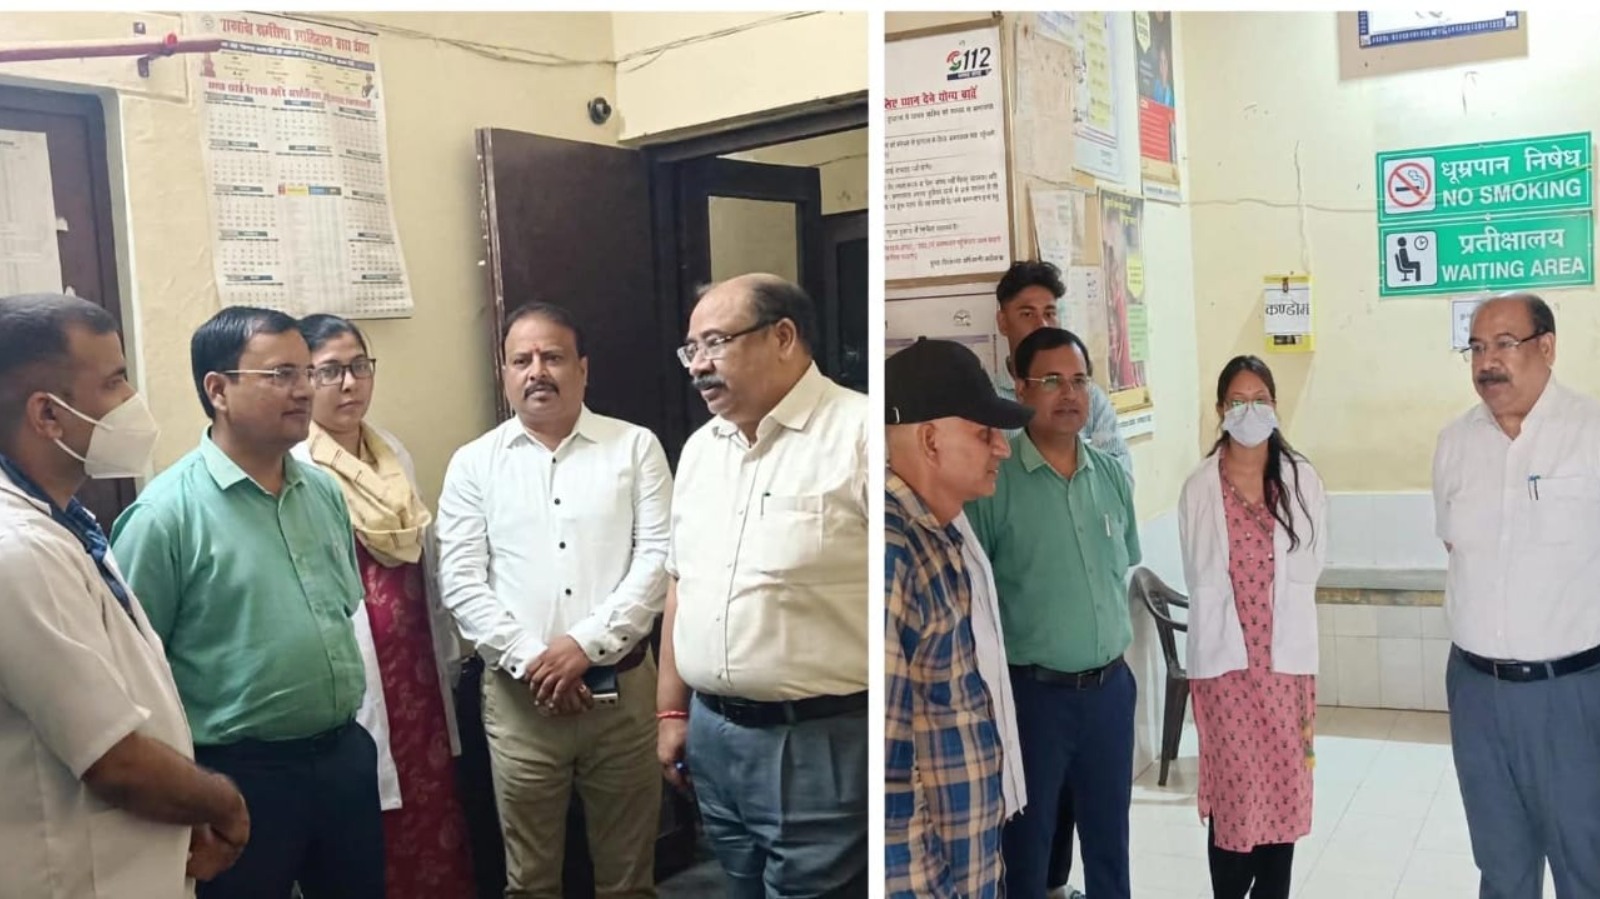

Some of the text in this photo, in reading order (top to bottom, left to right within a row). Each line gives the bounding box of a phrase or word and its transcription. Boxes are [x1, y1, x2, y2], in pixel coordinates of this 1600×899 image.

[963, 46, 991, 70] 112
[901, 95, 920, 107] ध्यान
[922, 91, 936, 103] देने
[938, 89, 958, 101] योग्य
[961, 85, 978, 100] बातें
[1441, 145, 1583, 184] धूम्रपान निषेध
[1442, 178, 1582, 207] NO SMOKING
[1458, 226, 1566, 254] प्रतीक्षालय
[1441, 257, 1586, 282] WAITING AREA
